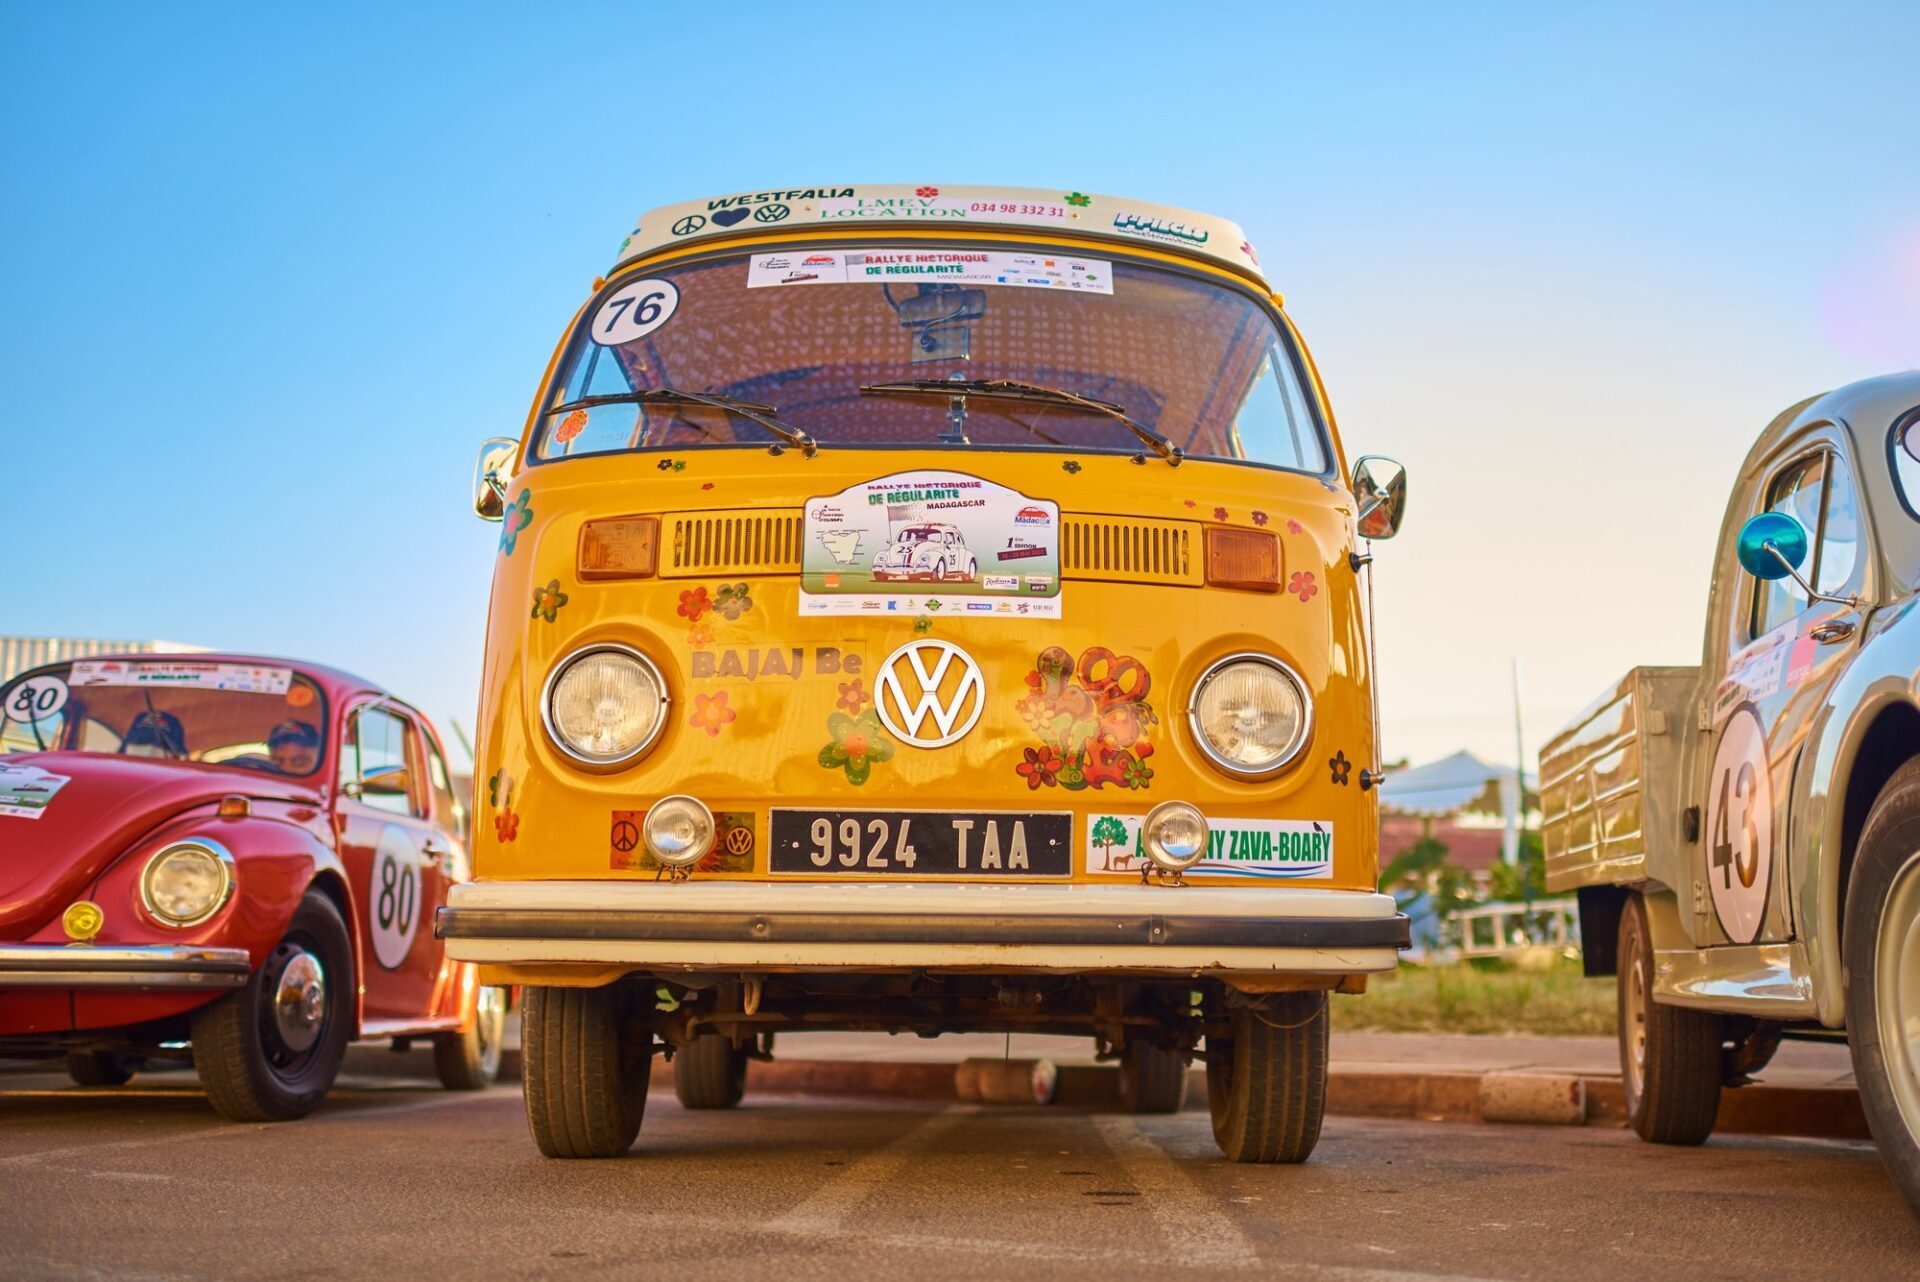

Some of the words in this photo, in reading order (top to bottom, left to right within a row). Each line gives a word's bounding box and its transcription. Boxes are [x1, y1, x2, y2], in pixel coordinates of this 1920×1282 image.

[707, 188, 854, 210] WESTFALIA
[857, 199, 936, 208] LMEV
[821, 208, 967, 218] LOCATION
[971, 202, 996, 213] 034
[1000, 204, 1016, 214] 98
[1020, 205, 1045, 216] 332
[1049, 207, 1064, 218] 31
[865, 254, 912, 264] RALLYE
[916, 253, 988, 263] HISTORIQUE
[865, 266, 882, 275] DE
[885, 263, 964, 275] RÉGULARITÉ
[605, 292, 665, 333] 76
[868, 493, 884, 505] DE
[887, 488, 960, 503] RÉGULARITÉ
[926, 500, 985, 510] MADAGASCAR
[897, 545, 913, 554] 25
[691, 648, 804, 682] BAJAJ
[815, 647, 863, 675] Be
[14, 687, 58, 711] 80
[1713, 760, 1759, 889] 43
[810, 818, 917, 869] 9924
[952, 820, 1029, 870] TAA
[1229, 829, 1331, 863] ZAVA-BOARY
[378, 854, 415, 937] 80
